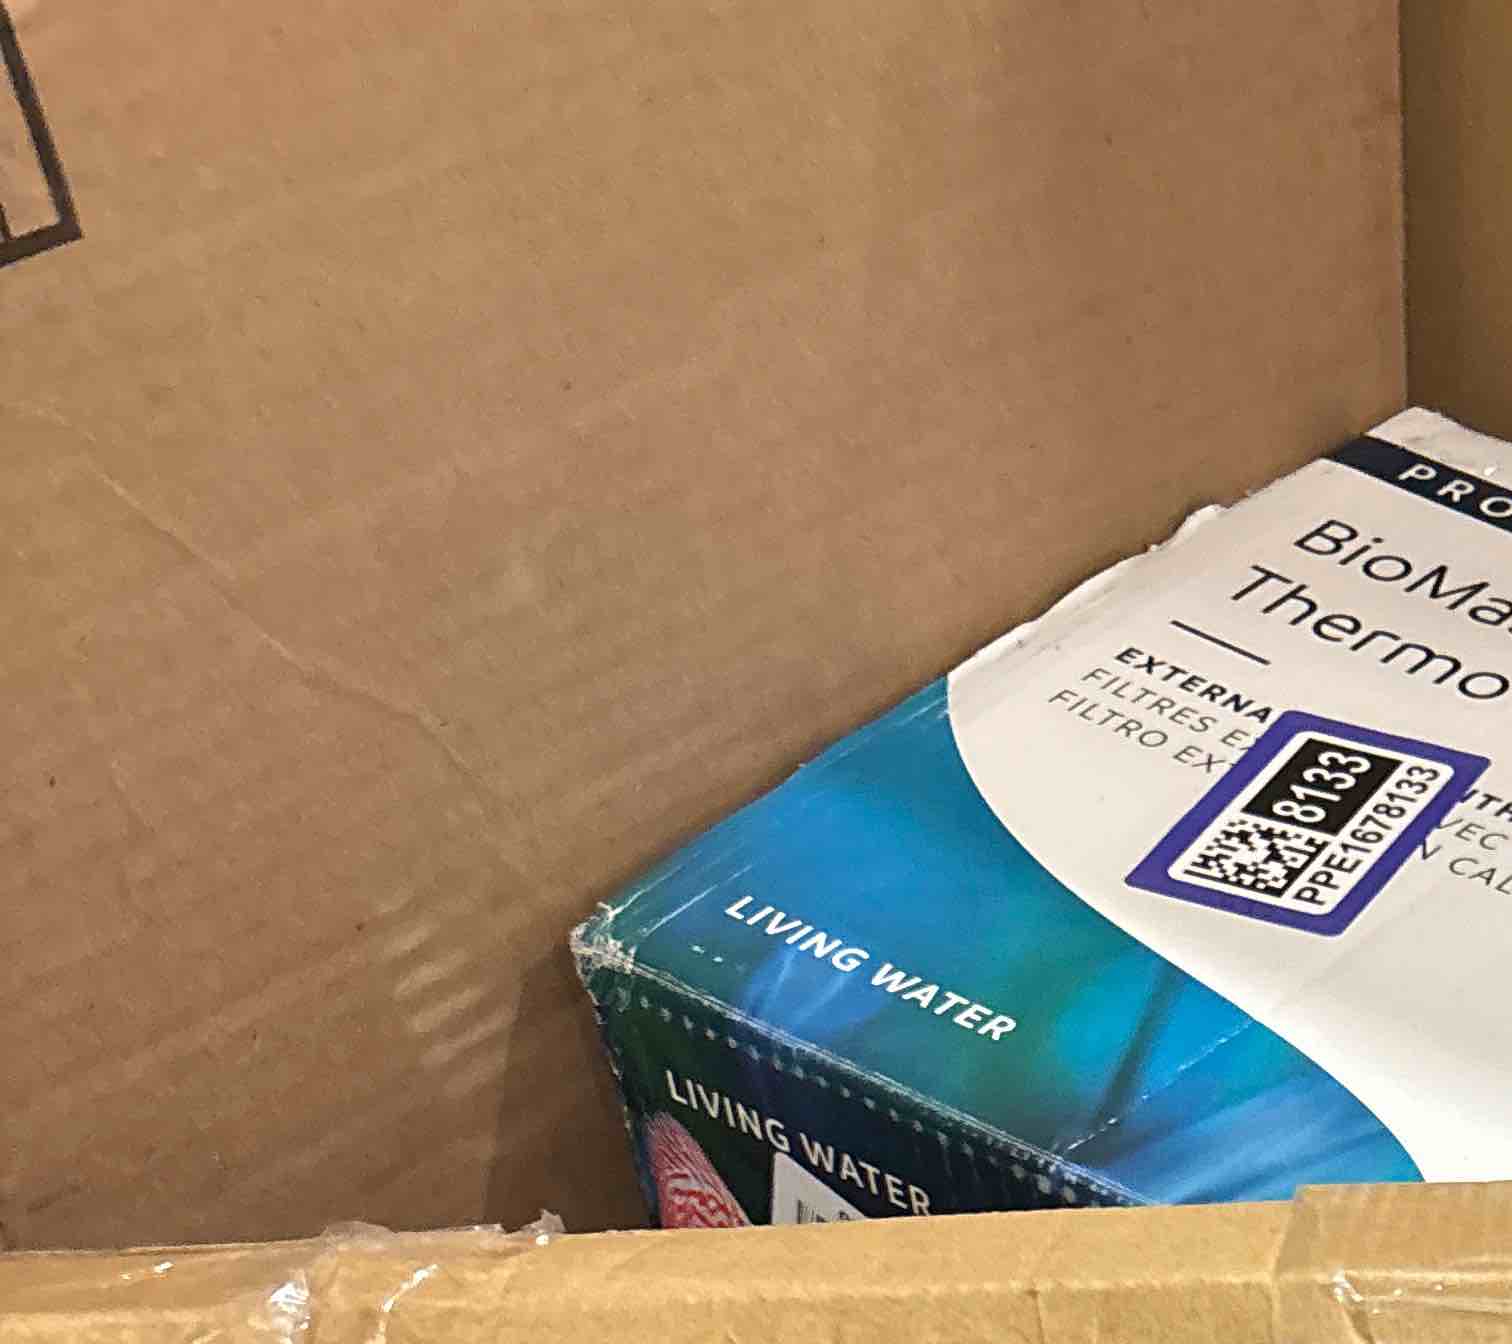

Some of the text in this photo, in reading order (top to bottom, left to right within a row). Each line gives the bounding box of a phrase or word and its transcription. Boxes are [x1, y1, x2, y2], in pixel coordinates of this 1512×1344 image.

[1230, 564, 1510, 700] Thermo
[1049, 689, 1169, 748] FILTRO
[1081, 667, 1218, 733] FILTRES
[1115, 647, 1273, 724] EXTERNA
[1272, 750, 1372, 824] 8133
[1294, 764, 1441, 907] PPE1678133
[723, 895, 1018, 1041] LIVING WATER
[665, 1069, 932, 1216] LIVING WATER
